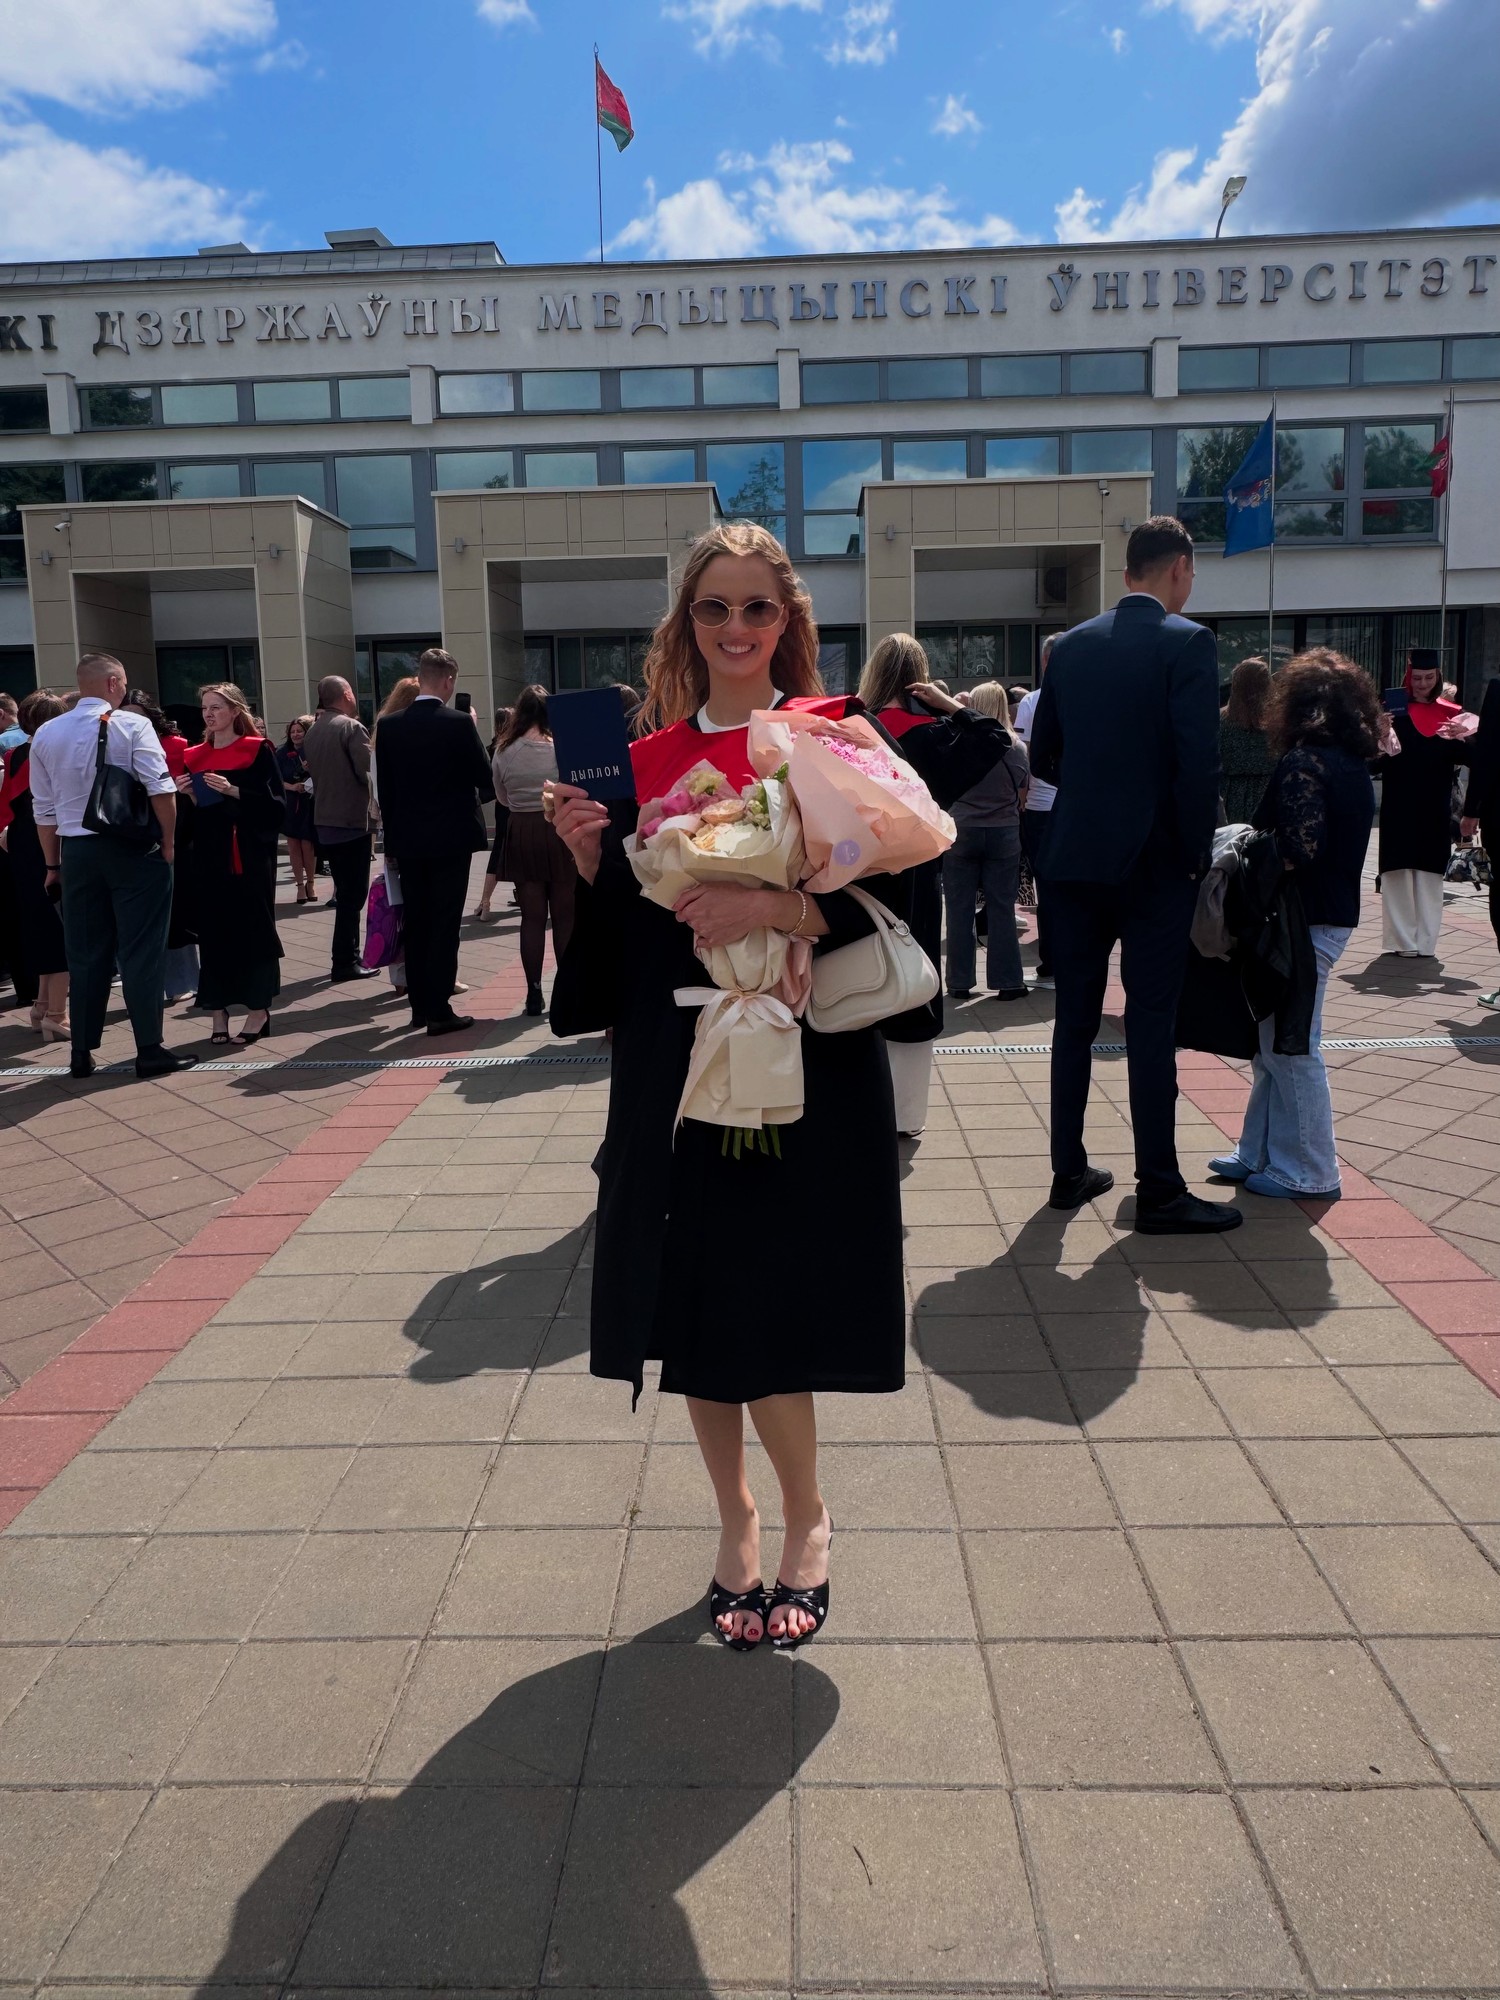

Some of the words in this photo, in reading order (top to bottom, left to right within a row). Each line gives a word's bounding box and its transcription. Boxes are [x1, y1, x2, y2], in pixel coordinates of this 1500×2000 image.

[93, 291, 500, 356] ДЗЯРЖАЎНЫ
[537, 275, 1008, 336] МЕДЫЦЫНСКІ
[1047, 254, 1498, 311] ЎНІВЕРСІТЭТ
